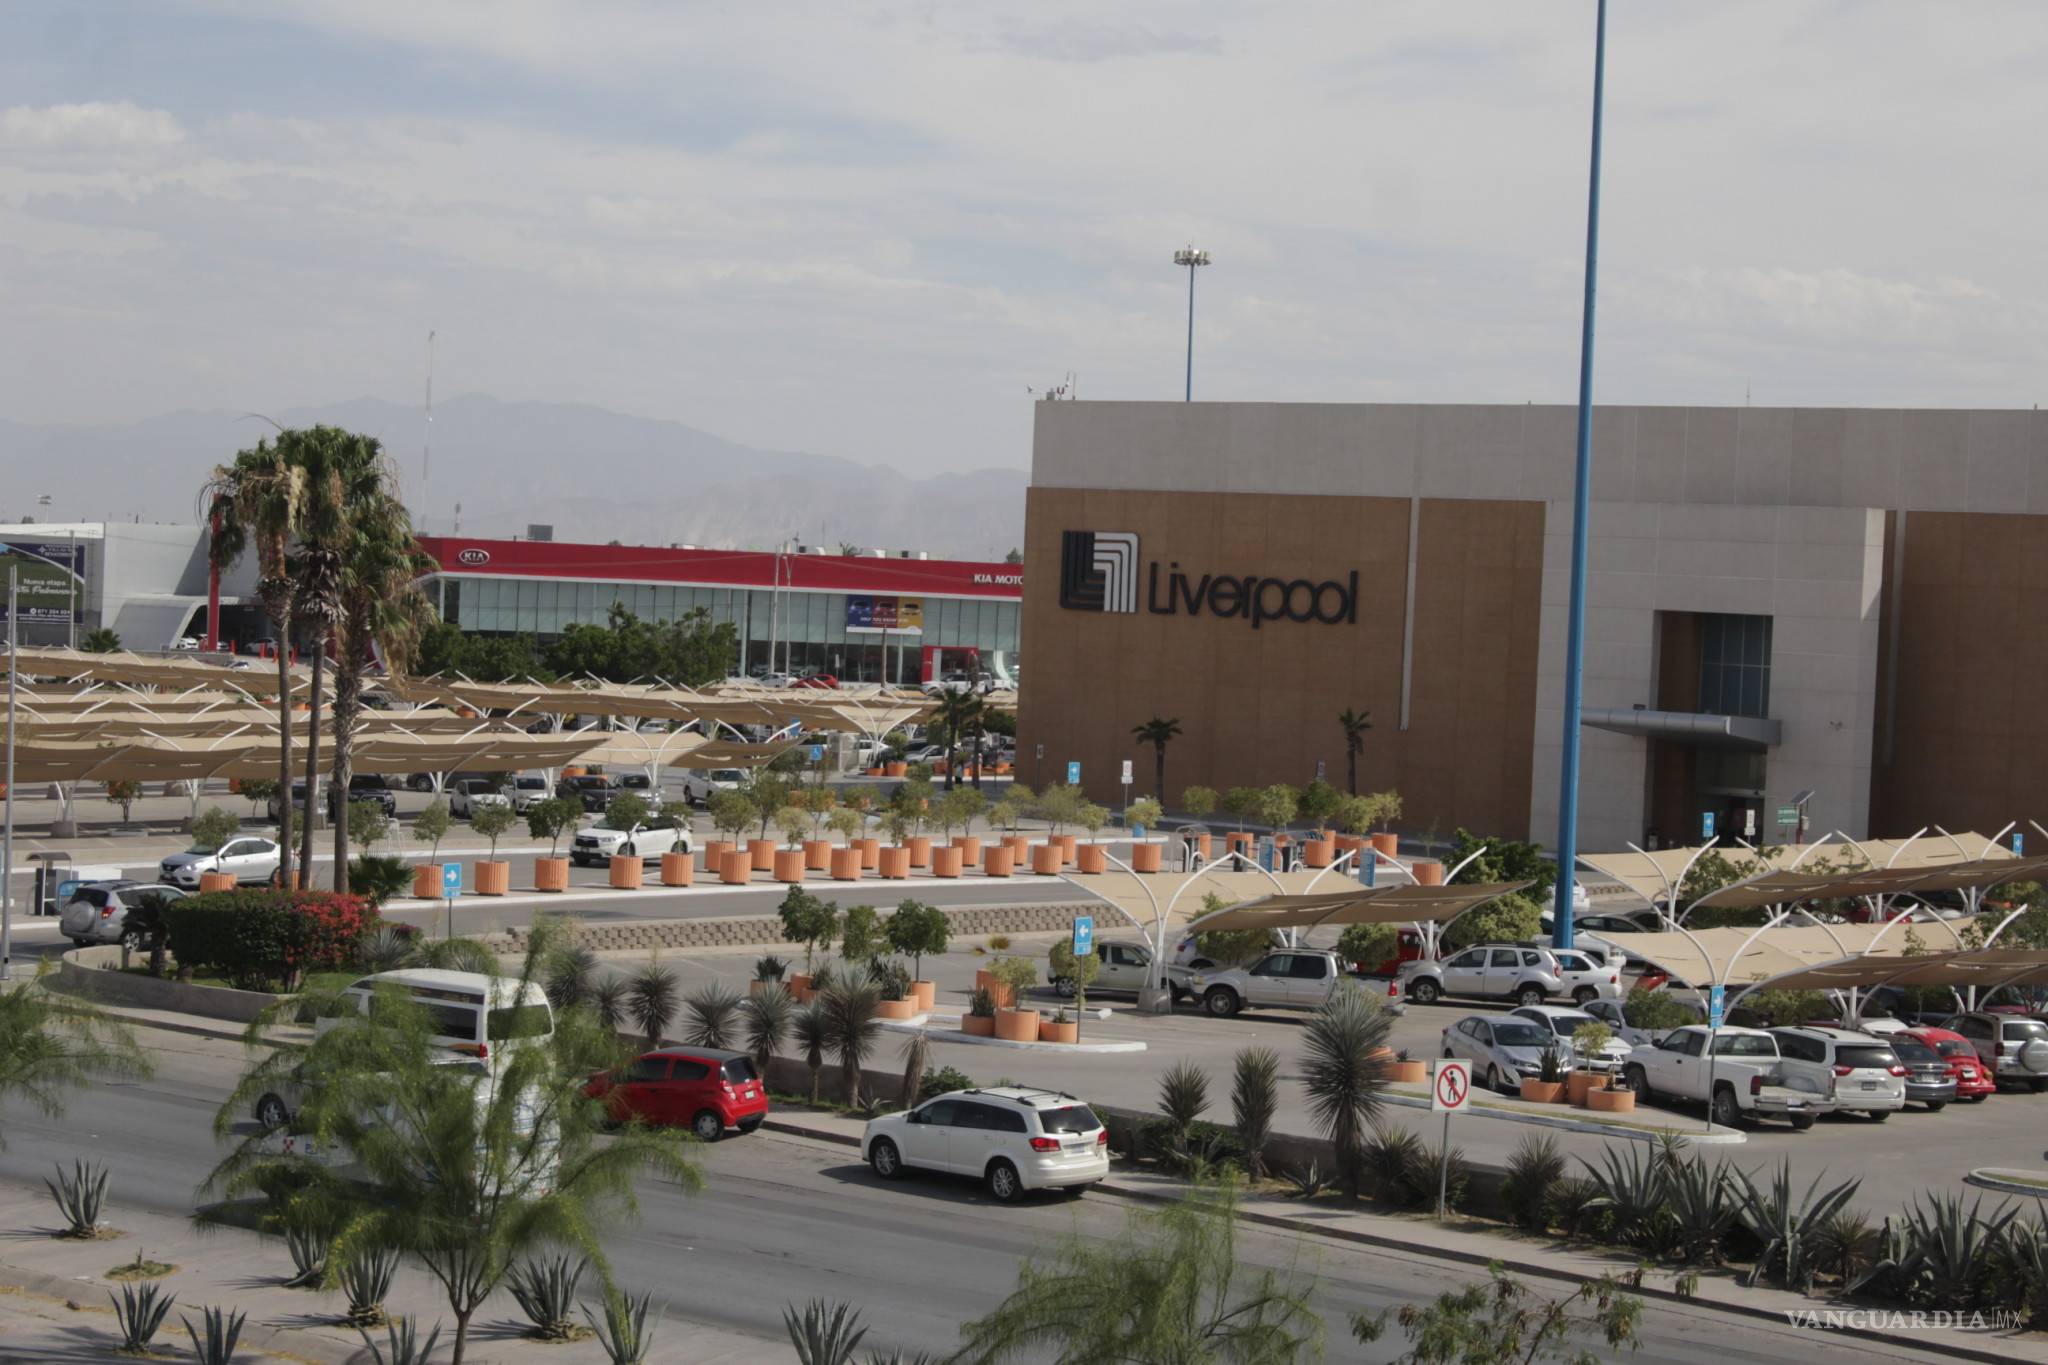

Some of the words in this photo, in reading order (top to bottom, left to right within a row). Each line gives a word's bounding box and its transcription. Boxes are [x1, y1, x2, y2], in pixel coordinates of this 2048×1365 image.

[463, 551, 485, 562] KIA
[973, 573, 992, 584] KIA
[1148, 561, 1359, 630] Liverpool
